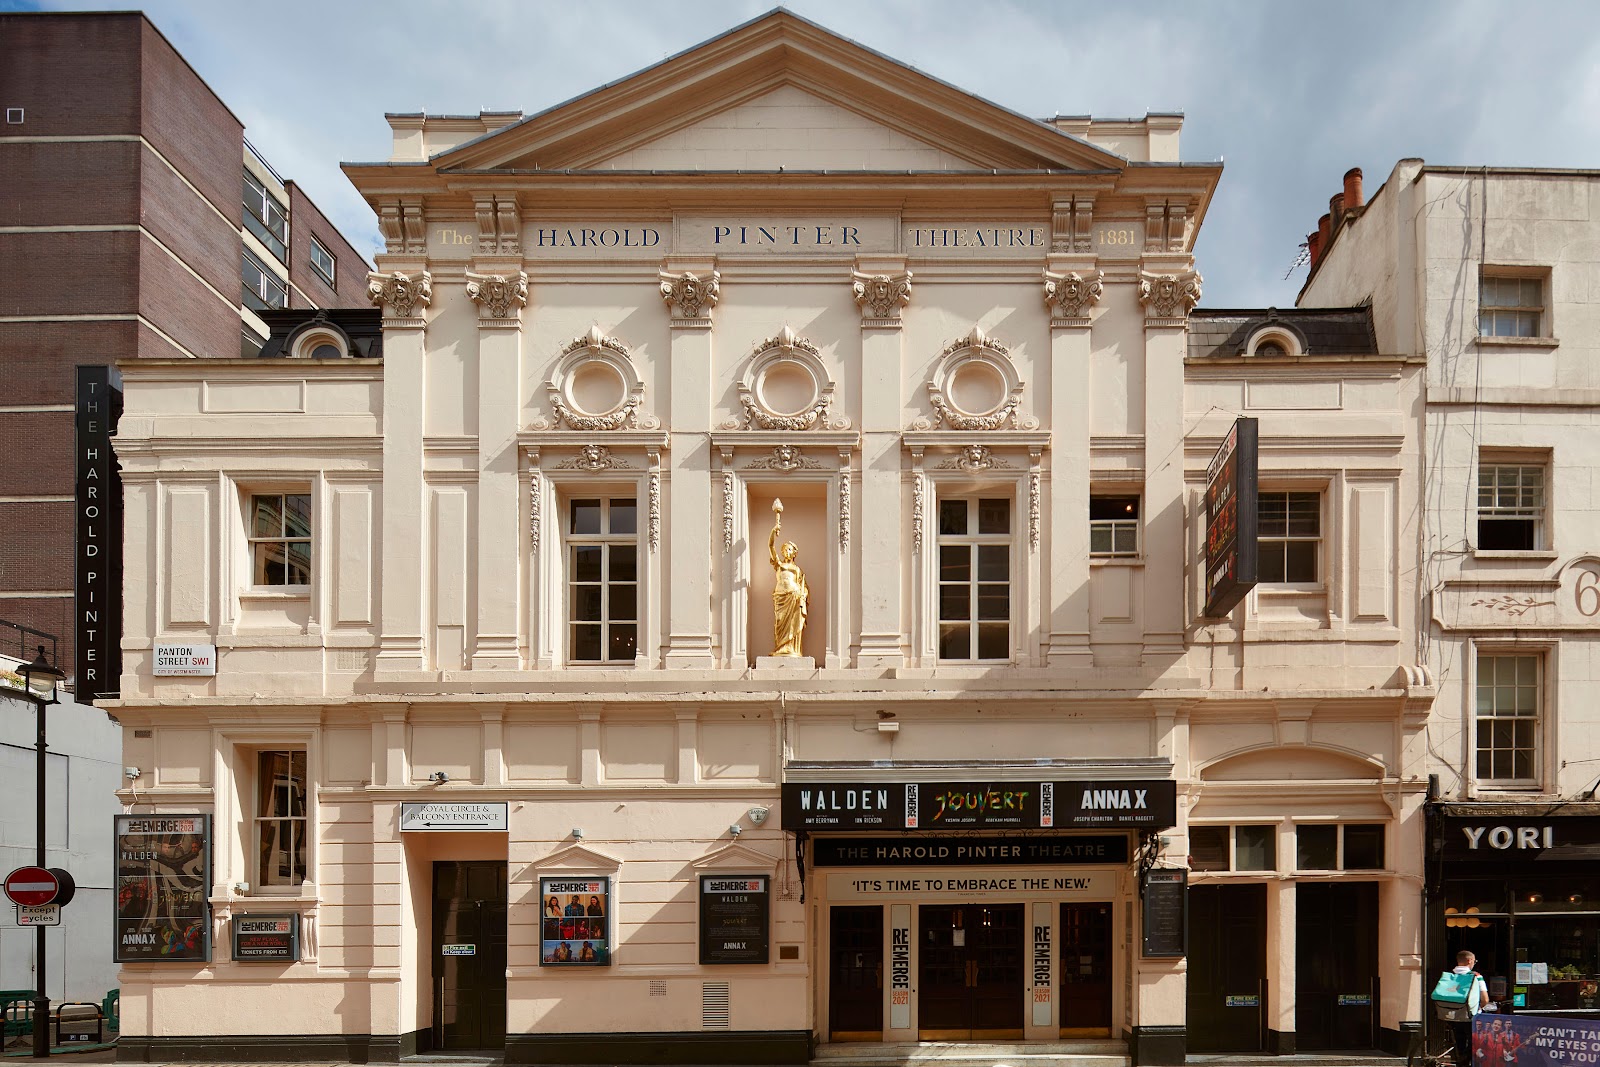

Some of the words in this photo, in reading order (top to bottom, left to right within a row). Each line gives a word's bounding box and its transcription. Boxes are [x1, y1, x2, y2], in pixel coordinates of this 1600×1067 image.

[437, 229, 473, 245] The
[536, 228, 660, 247] HAROLD
[712, 226, 862, 245] PINTER
[908, 228, 1045, 247] THEATRE
[1099, 230, 1136, 245] 1881
[87, 382, 98, 433] THE
[86, 448, 98, 557] HAROLD
[1575, 570, 1600, 616] 6
[86, 572, 98, 680] PINTER
[158, 647, 193, 656] PANTON
[158, 657, 188, 666] STREET
[192, 657, 209, 666] SW1
[801, 790, 887, 810] WALDEN
[933, 787, 1029, 820] J'OUVERT
[1081, 789, 1131, 809] ANNA
[1134, 789, 1147, 809] X
[1501, 807, 1528, 815] Street
[143, 820, 179, 832] EMERGE
[180, 824, 194, 832] 2021
[1462, 826, 1553, 849] YORI
[122, 851, 158, 860] WALDEN
[837, 847, 869, 859] THE
[876, 846, 949, 858] HAROLD
[957, 845, 1021, 858] PINTER
[1029, 845, 1105, 857] THEATRE
[550, 883, 560, 892] RE
[560, 882, 588, 893] EMERGE
[721, 881, 748, 891] EMERGE
[886, 880, 921, 891] TIME
[925, 880, 943, 890] TO
[947, 879, 1017, 890] EMBRACE
[1021, 878, 1050, 889] THE
[22, 906, 56, 914] Except
[22, 914, 54, 922] ycles
[241, 922, 251, 931] RE
[251, 921, 278, 931] EMERGE
[122, 934, 148, 944] ANNA
[149, 934, 156, 944] X
[892, 928, 909, 944] RE
[1034, 926, 1050, 942] RE
[892, 944, 909, 989] EMERGE
[1034, 942, 1050, 987] EMERGE
[892, 996, 909, 1005] 2021
[1034, 993, 1050, 1002] 2021
[1536, 1037, 1554, 1047] MY
[1558, 1040, 1587, 1050] EYES
[1549, 1049, 1566, 1059] OF
